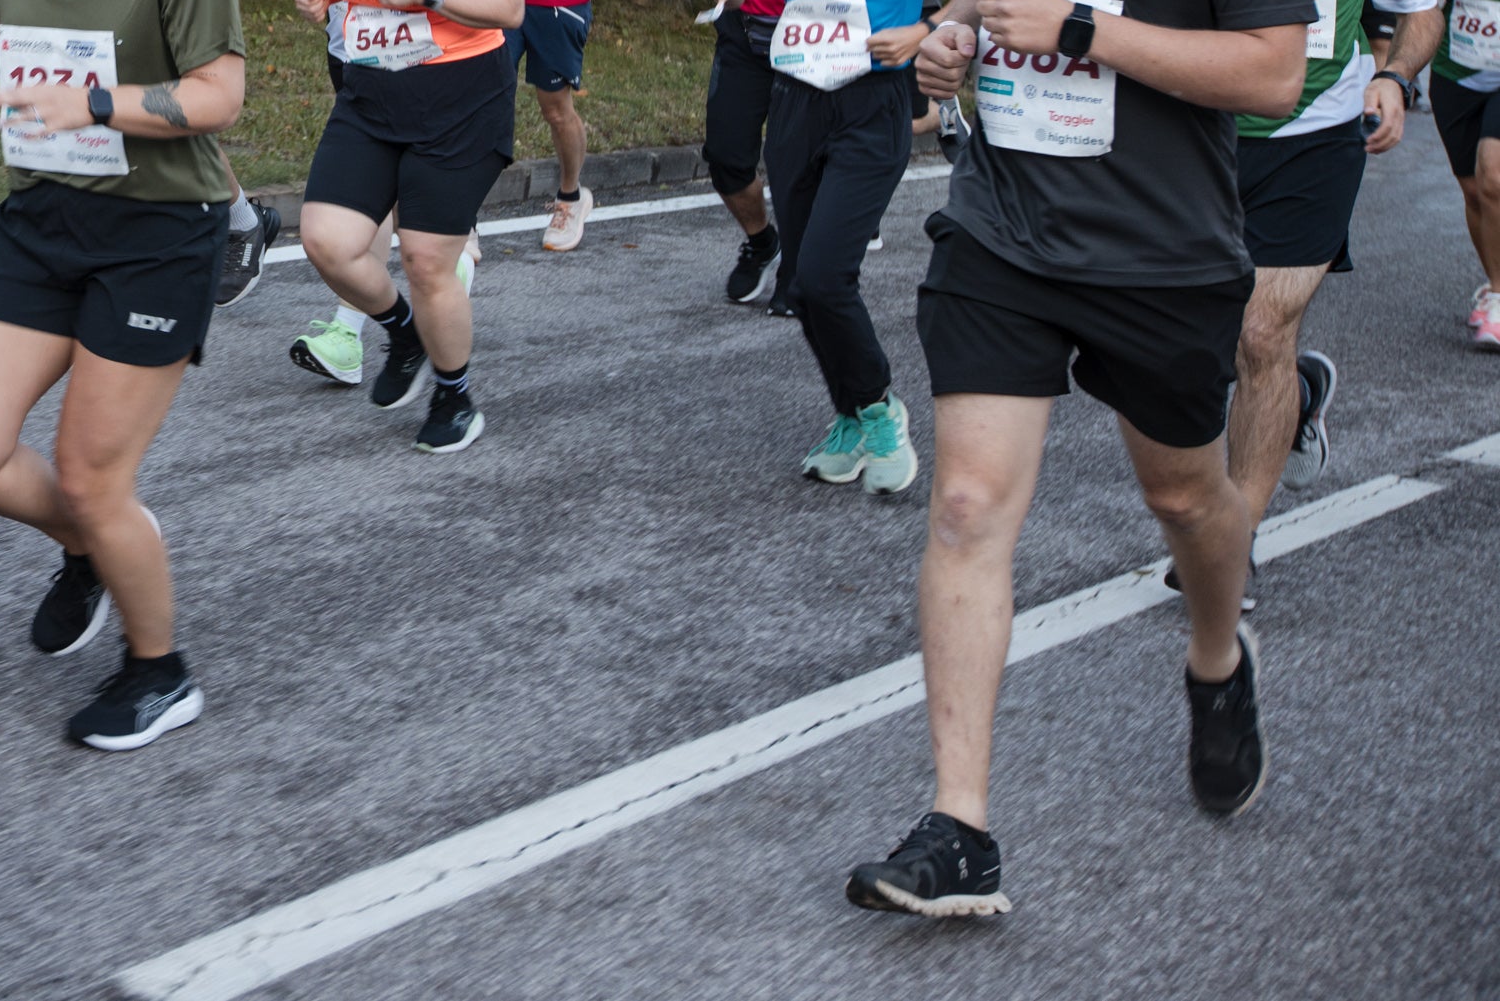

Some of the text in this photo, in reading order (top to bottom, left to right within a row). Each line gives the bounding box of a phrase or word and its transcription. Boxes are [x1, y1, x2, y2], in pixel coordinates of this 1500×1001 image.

[1457, 15, 1500, 38] 186
[1042, 89, 1104, 105] Auto Brenner
[1048, 110, 1096, 128] Torggler
[1047, 131, 1106, 146] hightides
[241, 243, 253, 267] PUMA
[127, 311, 179, 334] IDV
